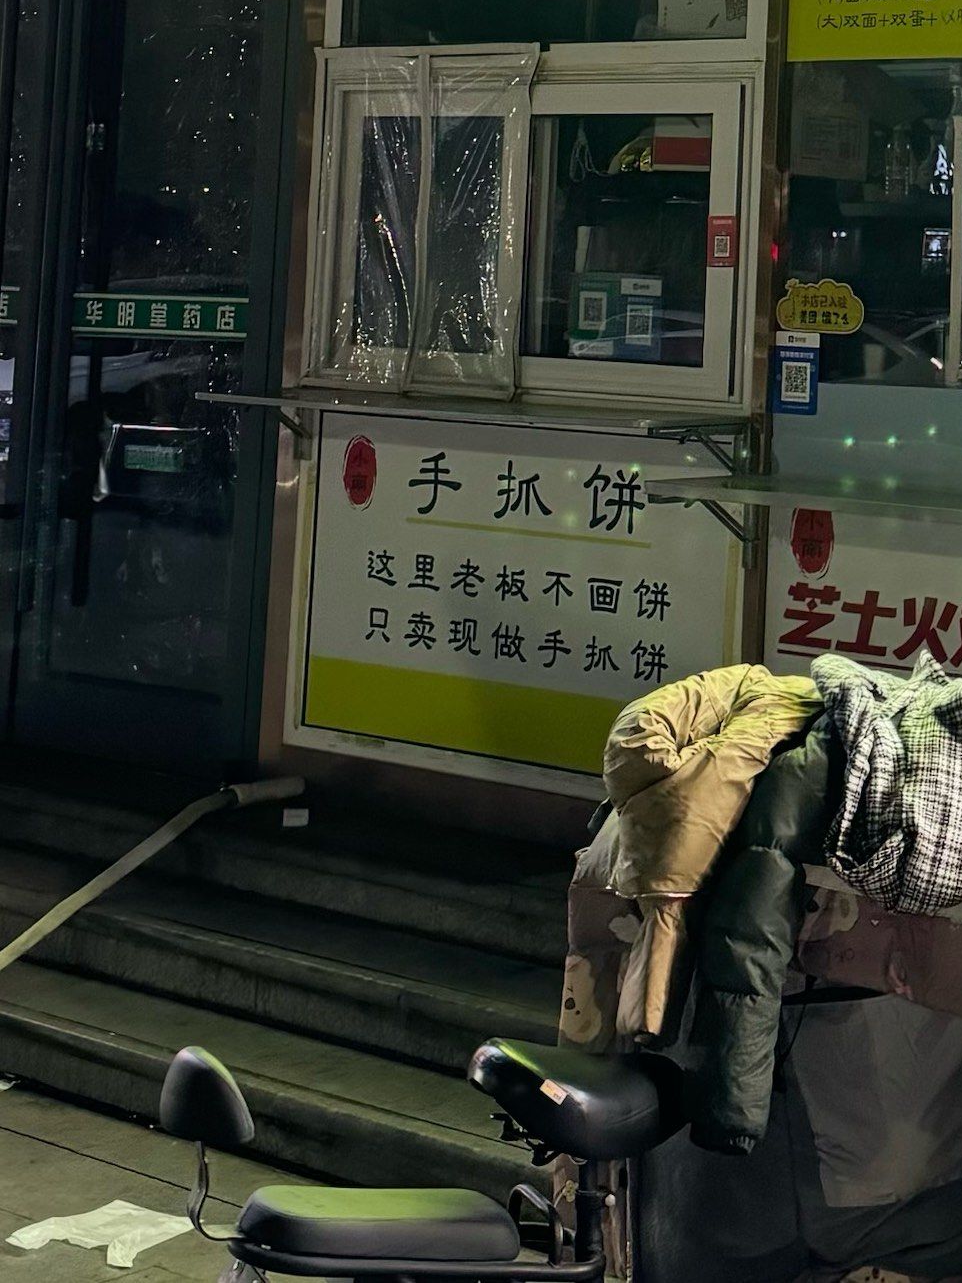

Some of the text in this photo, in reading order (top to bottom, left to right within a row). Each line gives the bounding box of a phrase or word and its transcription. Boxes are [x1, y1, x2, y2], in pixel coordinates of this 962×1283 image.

[85, 300, 236, 331] 华明堂药店
[408, 451, 646, 535] 手抓饼
[366, 549, 672, 622] 这里老板不画饼
[364, 606, 670, 684] 只卖现做手抓饼
